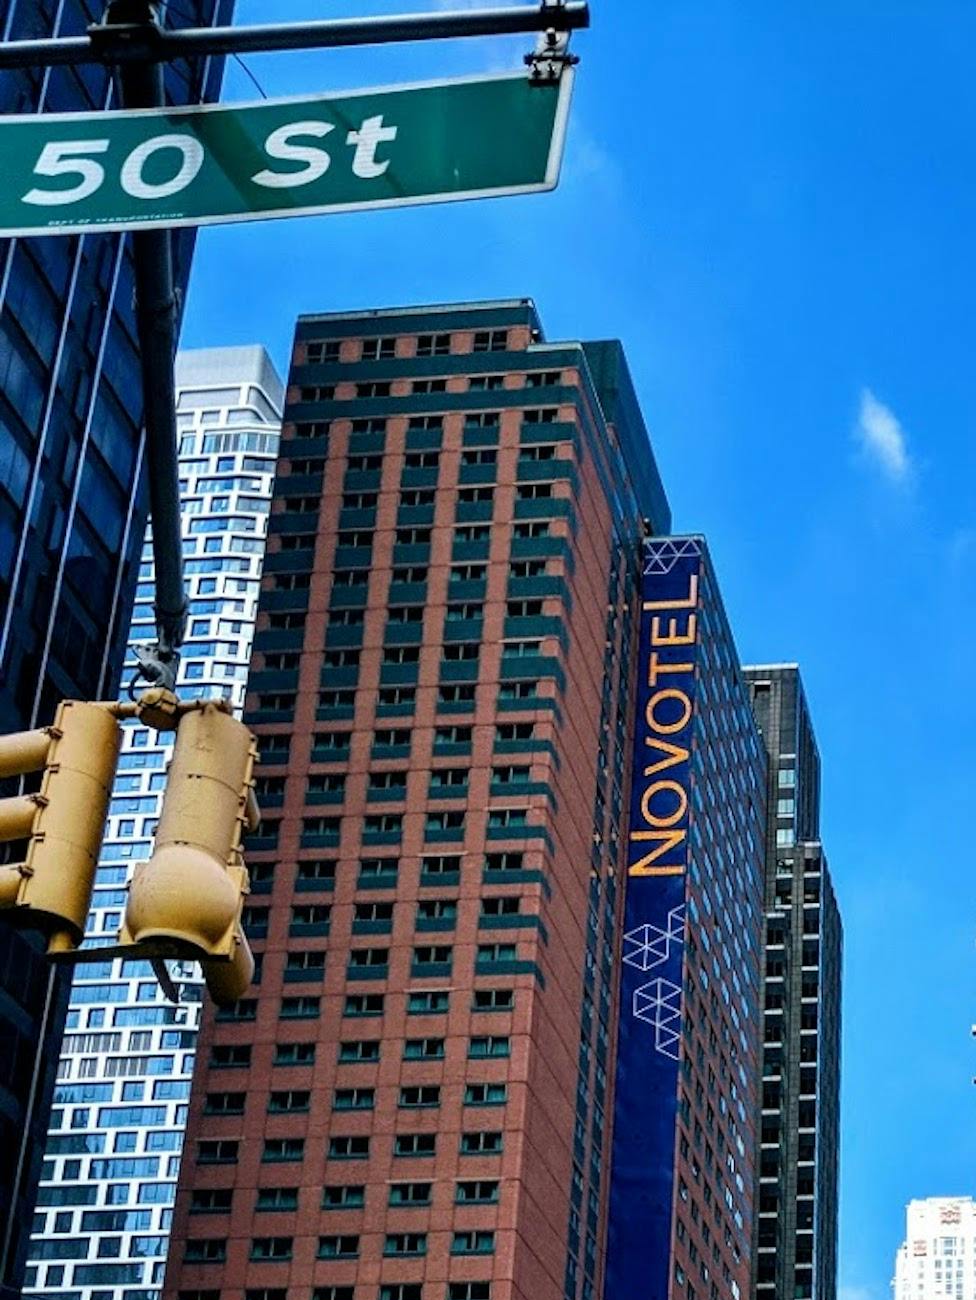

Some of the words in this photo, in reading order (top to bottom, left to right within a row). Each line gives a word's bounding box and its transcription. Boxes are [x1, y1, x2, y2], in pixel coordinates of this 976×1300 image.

[20, 133, 205, 206] 50
[250, 114, 398, 188] St
[628, 574, 698, 877] NOVOTEL
